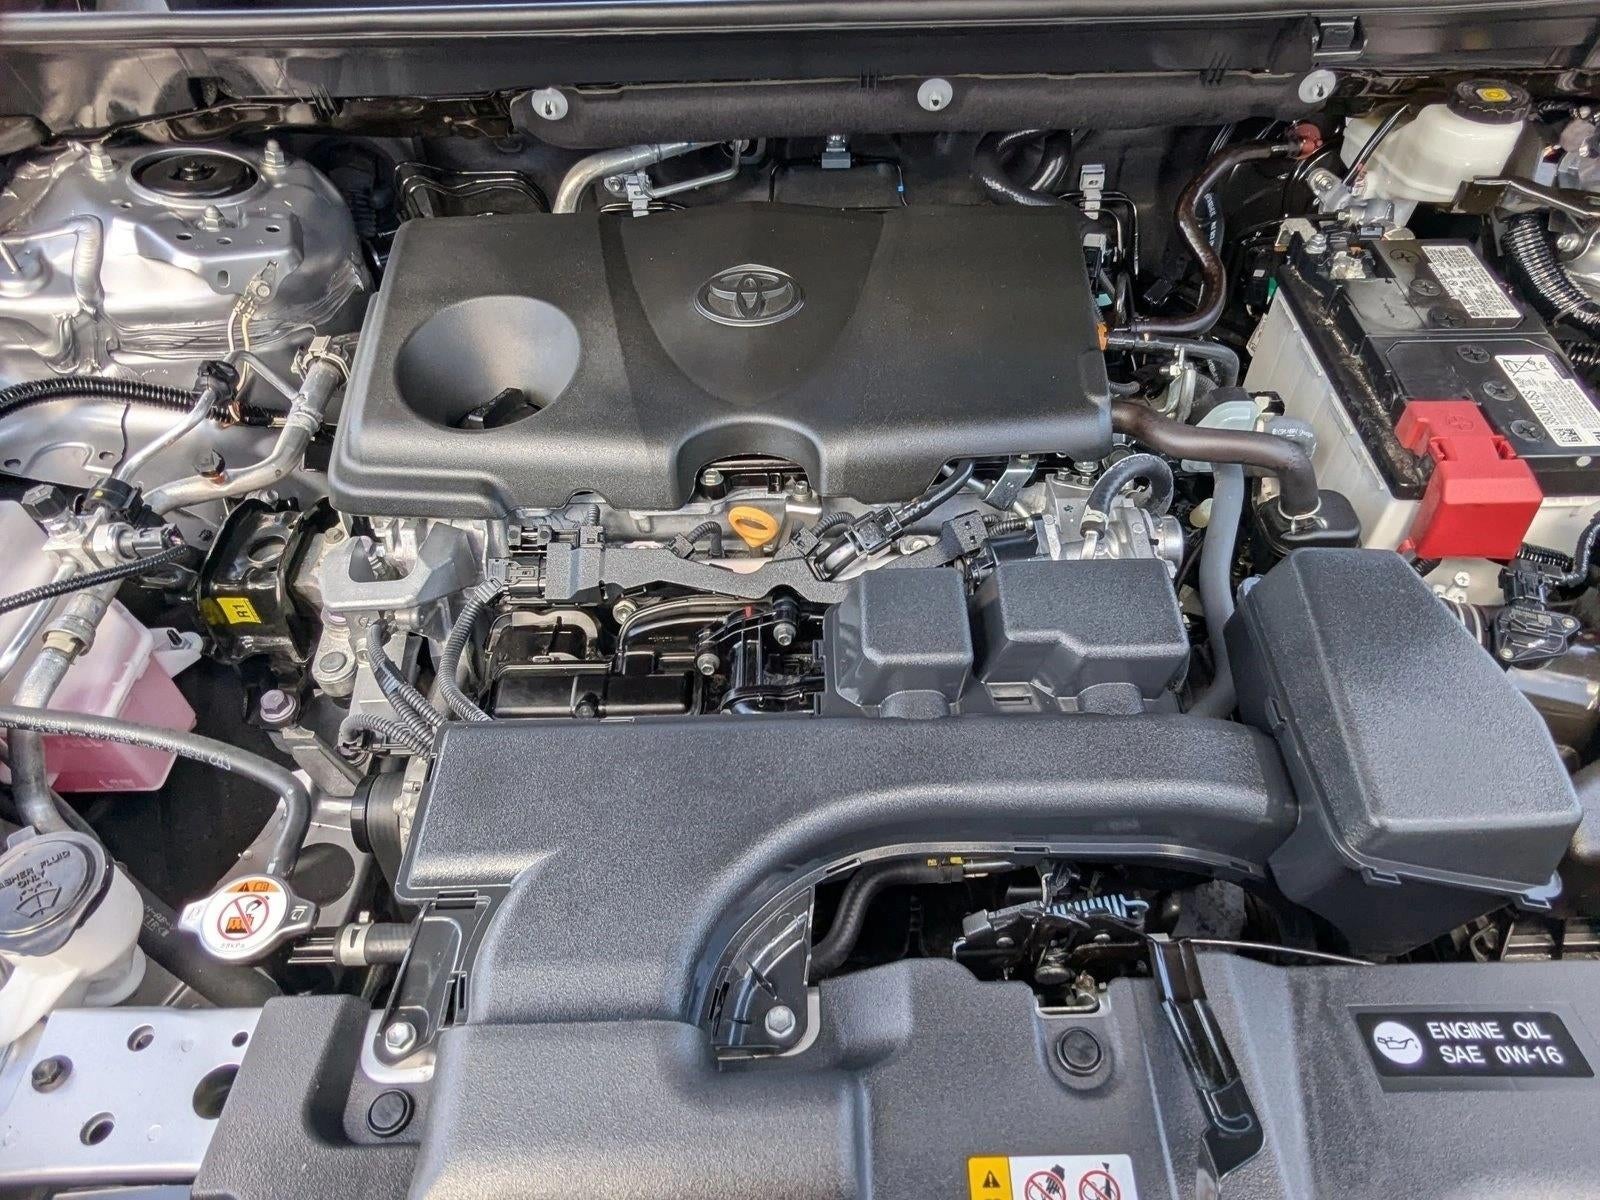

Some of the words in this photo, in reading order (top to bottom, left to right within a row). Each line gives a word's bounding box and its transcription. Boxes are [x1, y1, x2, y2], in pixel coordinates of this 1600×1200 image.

[232, 604, 251, 617] R1
[40, 850, 71, 869] FLUID
[17, 869, 46, 889] ONLY
[1427, 1021, 1505, 1040] ENGINE
[1512, 1021, 1553, 1040] OIL
[1438, 1045, 1487, 1064] SAE
[1494, 1045, 1564, 1065] 0W-16
